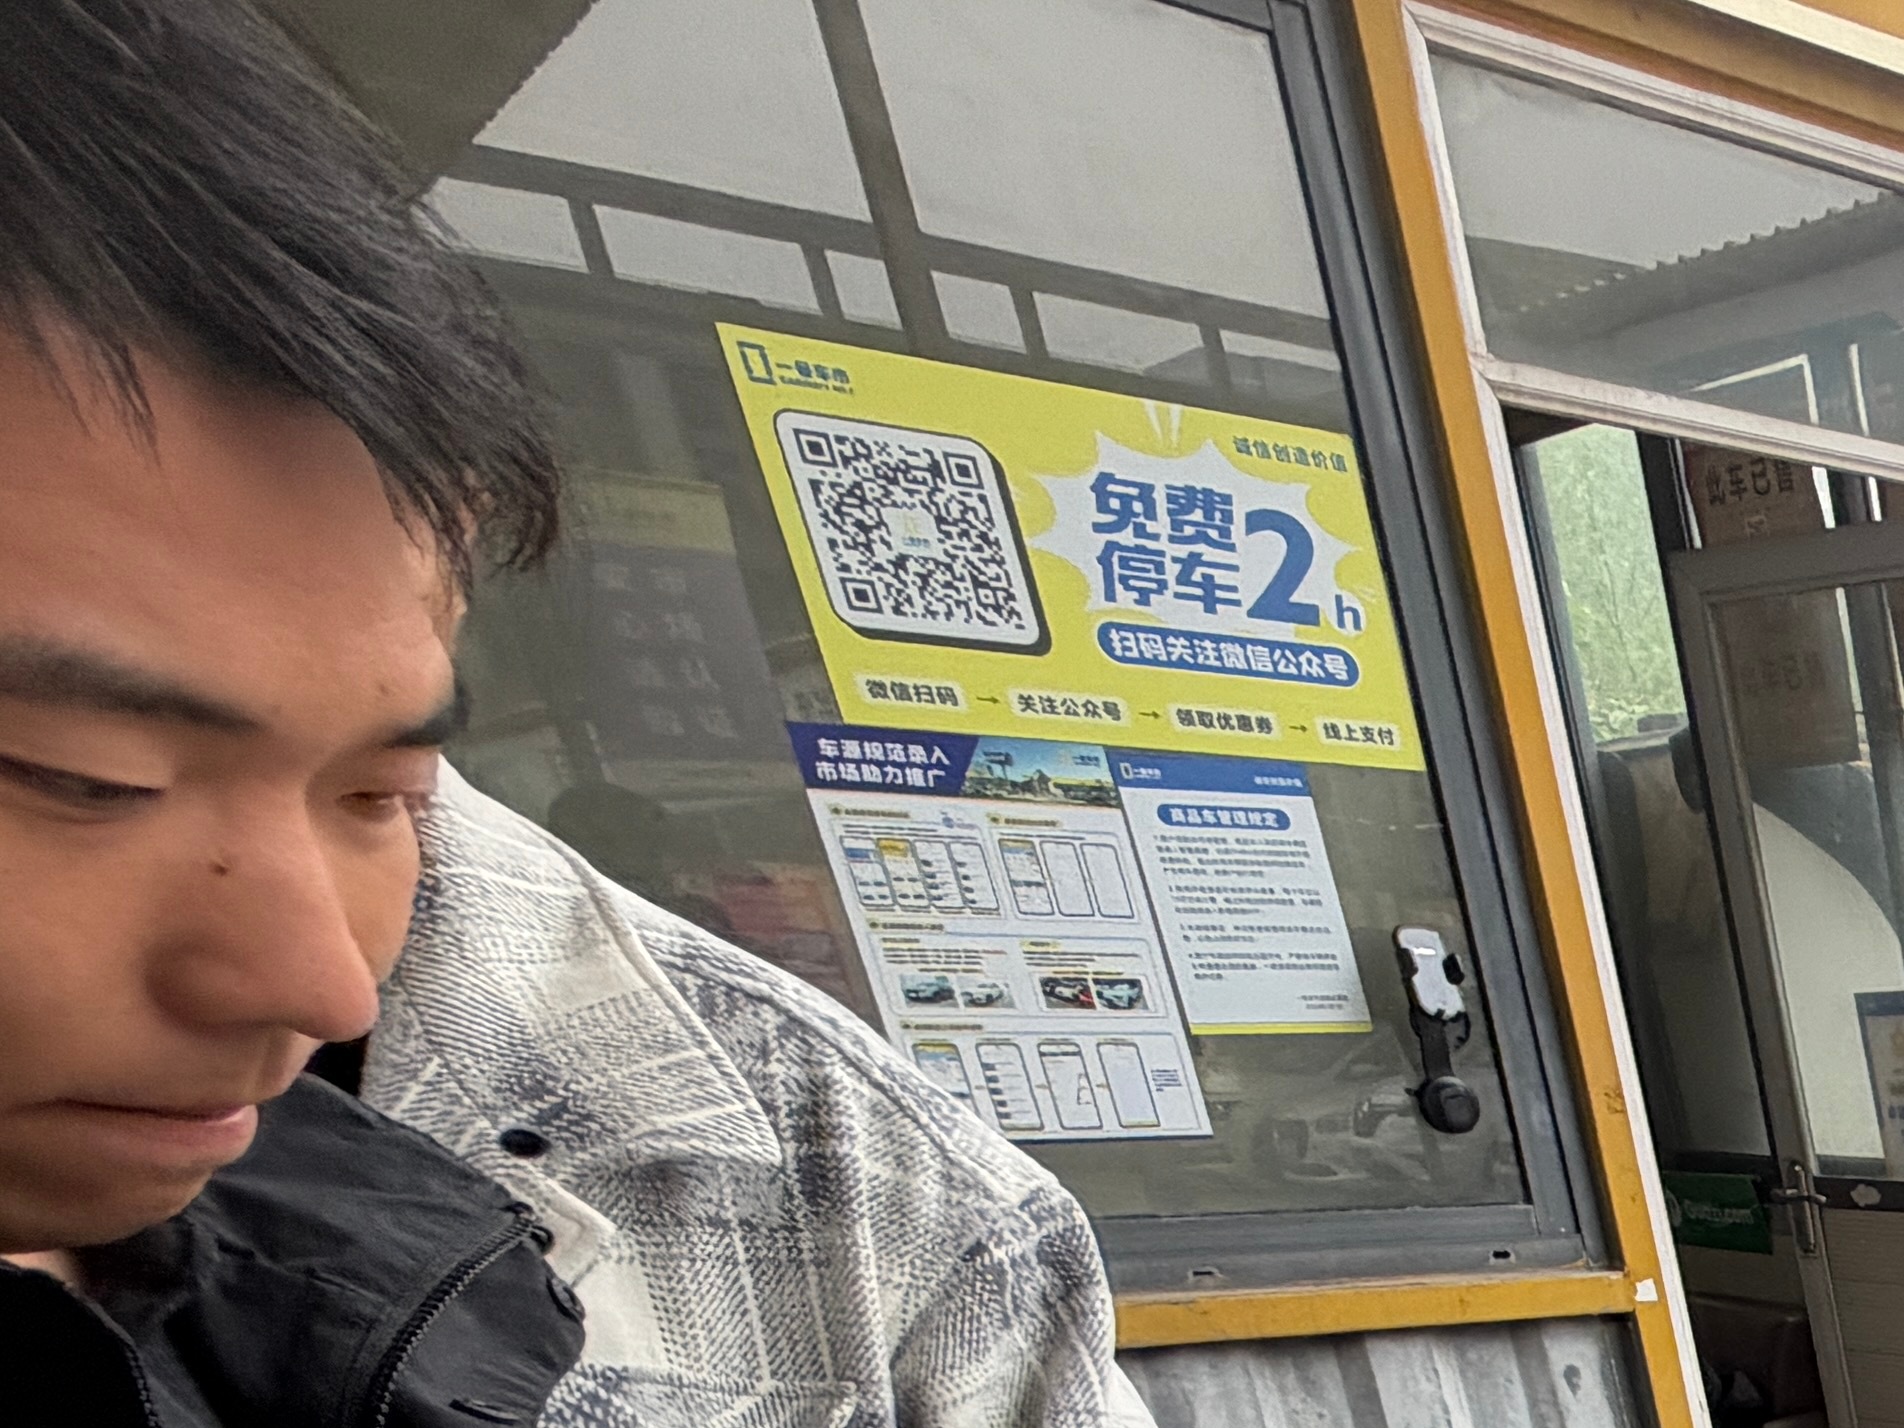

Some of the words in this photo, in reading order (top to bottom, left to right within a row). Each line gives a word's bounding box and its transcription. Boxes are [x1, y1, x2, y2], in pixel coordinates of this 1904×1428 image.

[1233, 435, 1348, 472] 诚信创造价值
[1089, 471, 1237, 553] 免费
[1096, 540, 1242, 615] 停车
[1245, 508, 1320, 627] 2
[1335, 594, 1363, 632] h
[1108, 628, 1350, 681] 扫码关注微信公众号
[865, 678, 960, 707] 微信扫码
[1018, 693, 1122, 723] 关注公众号
[1176, 707, 1273, 735] 领取优惠券
[1323, 721, 1396, 746] 线上支付
[815, 760, 946, 788] 市场助力推广
